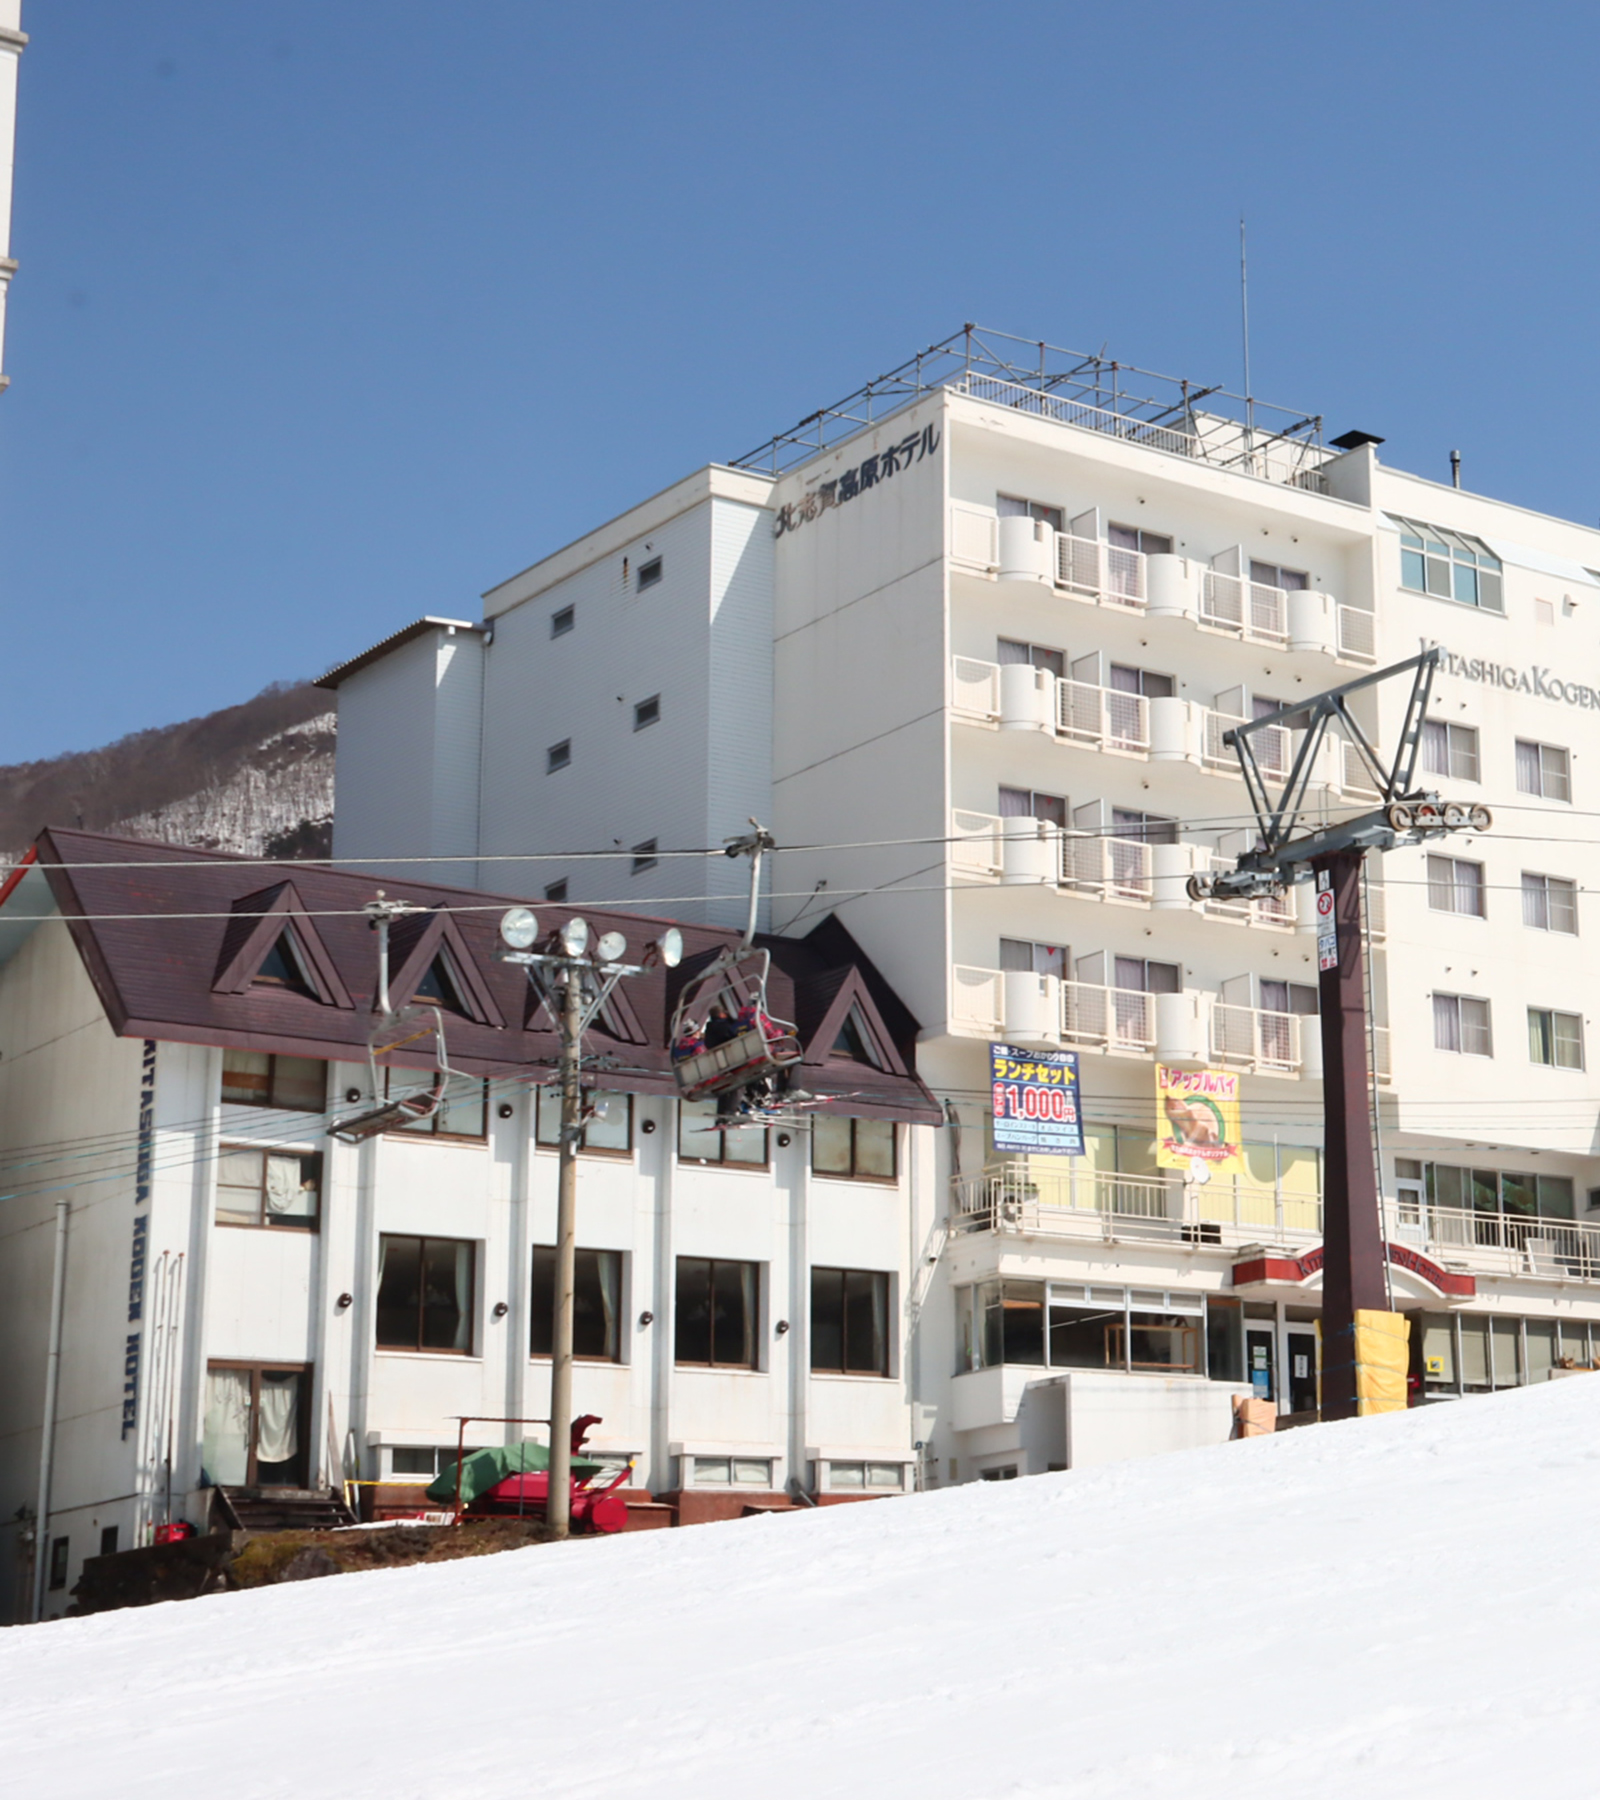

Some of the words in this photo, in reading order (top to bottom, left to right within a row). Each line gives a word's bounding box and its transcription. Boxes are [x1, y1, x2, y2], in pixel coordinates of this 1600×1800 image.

[774, 423, 941, 538] 北志賀高原ホテル
[993, 1058, 1076, 1085] ランチセット
[1171, 1069, 1236, 1094] アップルパイ
[128, 1214, 148, 1323] KOGEN
[121, 1332, 140, 1442] HOTEL
